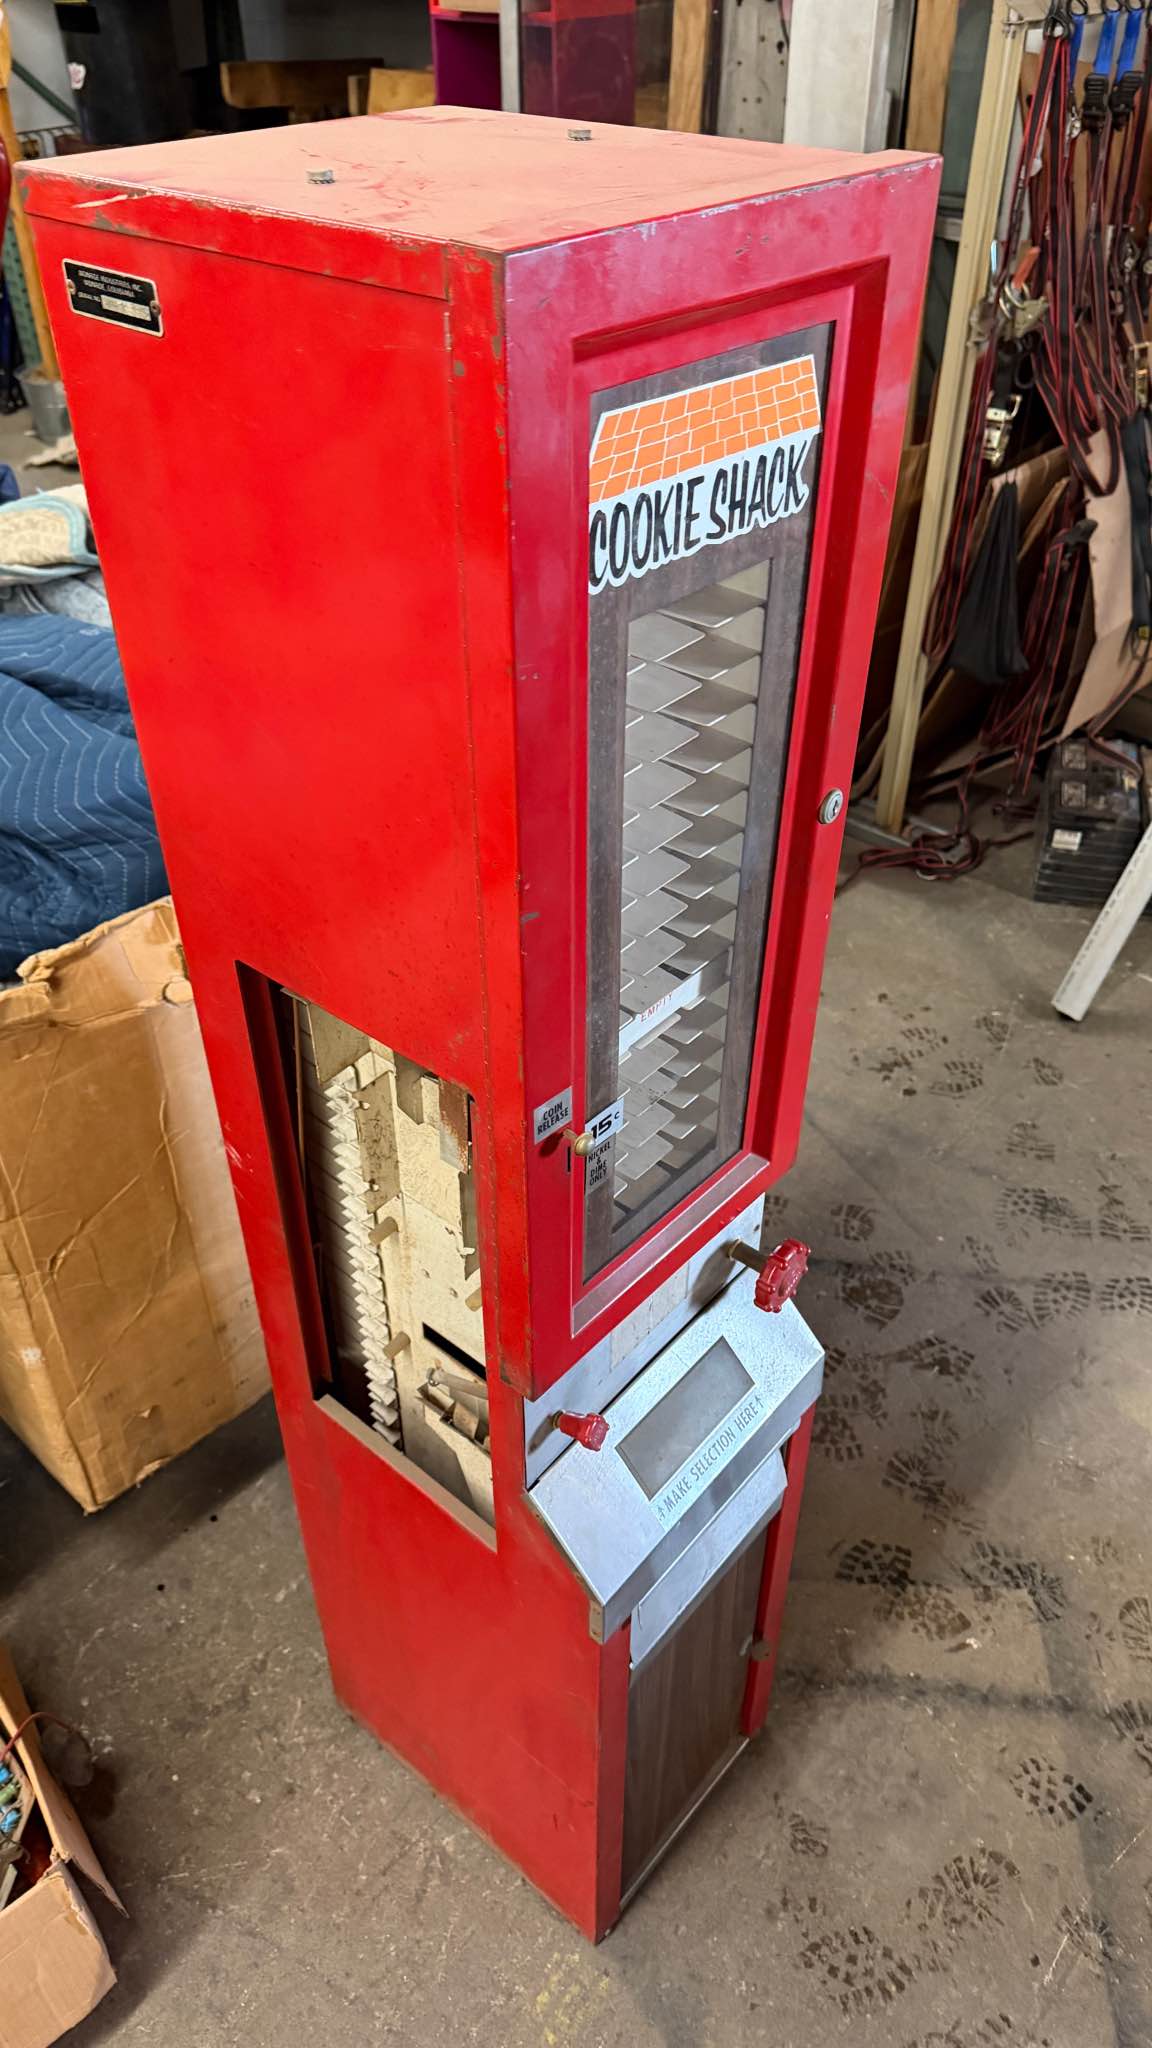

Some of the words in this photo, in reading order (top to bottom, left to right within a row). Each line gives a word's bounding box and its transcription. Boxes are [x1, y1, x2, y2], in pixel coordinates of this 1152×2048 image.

[589, 475, 704, 587] COOKIE
[706, 440, 807, 540] SHACK
[640, 992, 672, 1022] EMPTY
[537, 1106, 569, 1135] RELEASE
[543, 1101, 563, 1121] COIN
[588, 1141, 610, 1161] NICKEL
[589, 1169, 607, 1186] ONLY
[590, 1160, 607, 1177] DIME
[663, 1476, 692, 1513] MAKE
[690, 1426, 737, 1482] SELECTION
[734, 1402, 759, 1433] HERE
